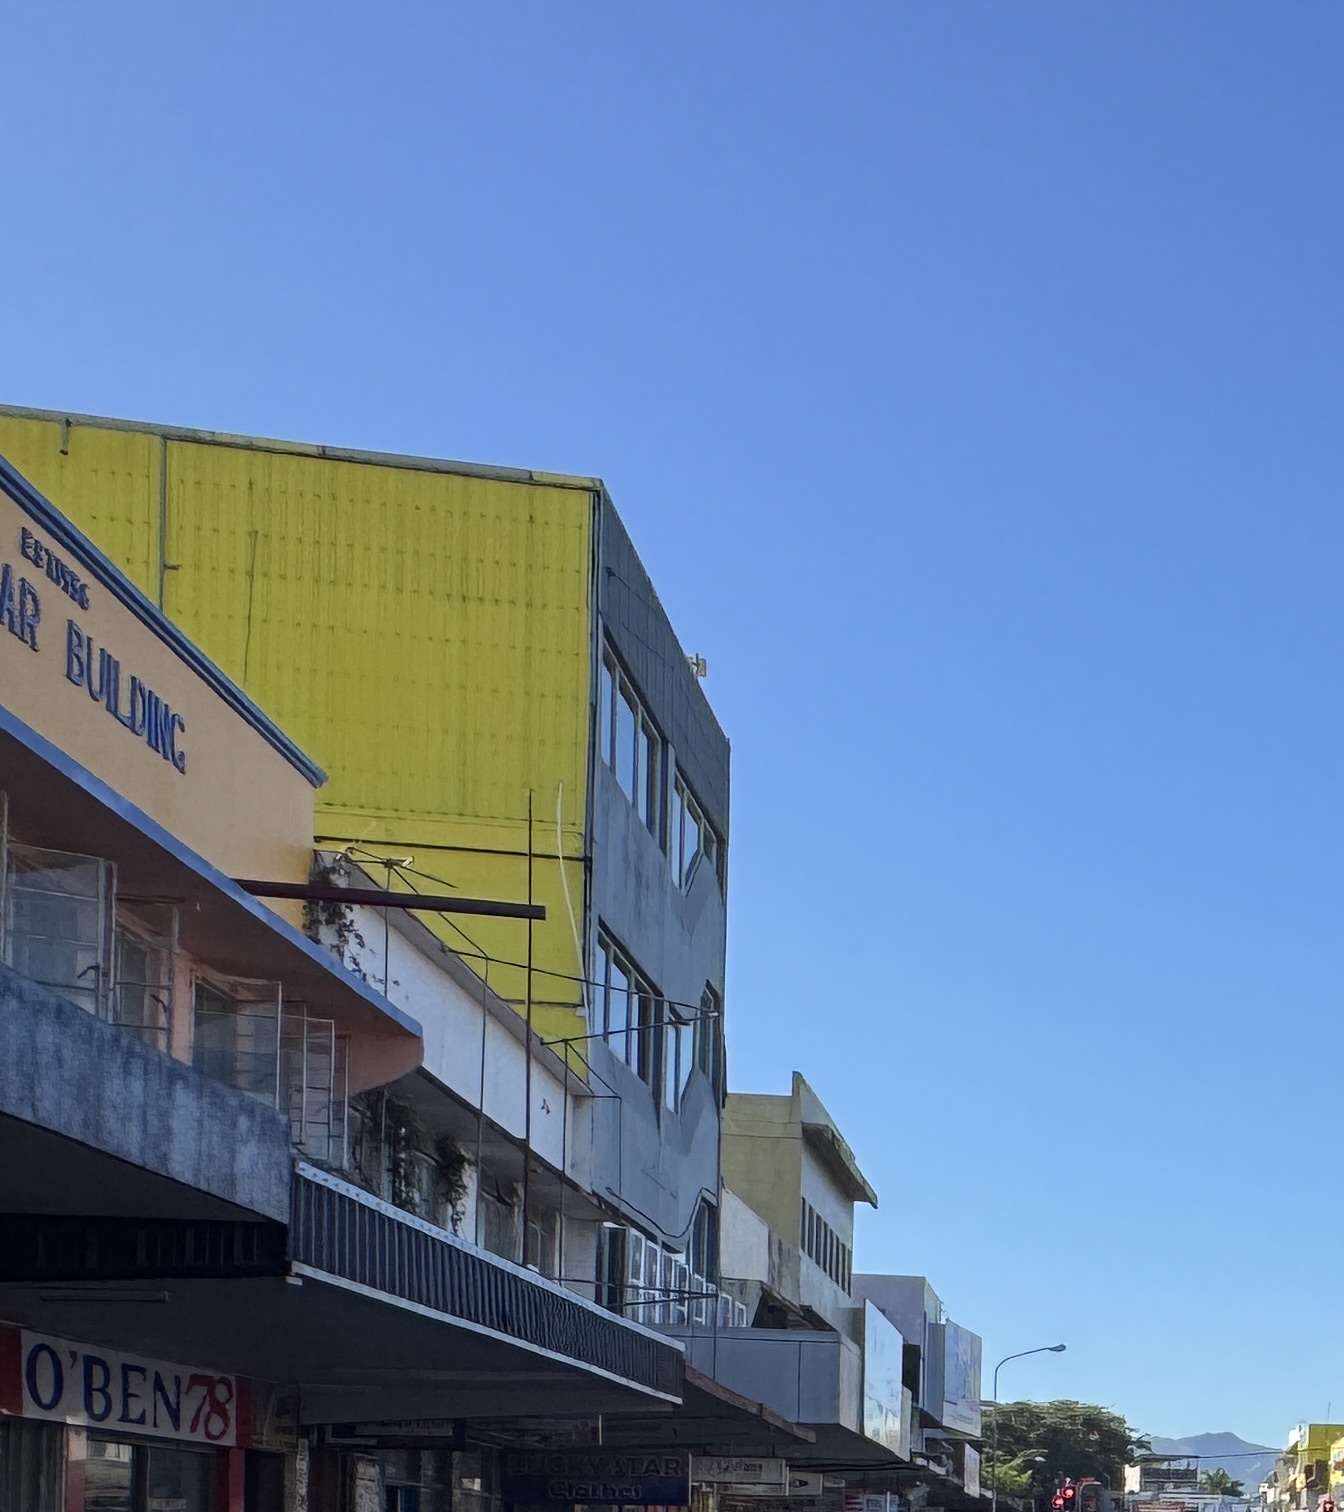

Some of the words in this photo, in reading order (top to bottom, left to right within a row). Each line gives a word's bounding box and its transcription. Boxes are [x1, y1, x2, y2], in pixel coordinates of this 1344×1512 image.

[64, 618, 187, 775] BUILDING
[508, 1453, 609, 1477] LUCKY
[611, 1455, 683, 1478] STAR
